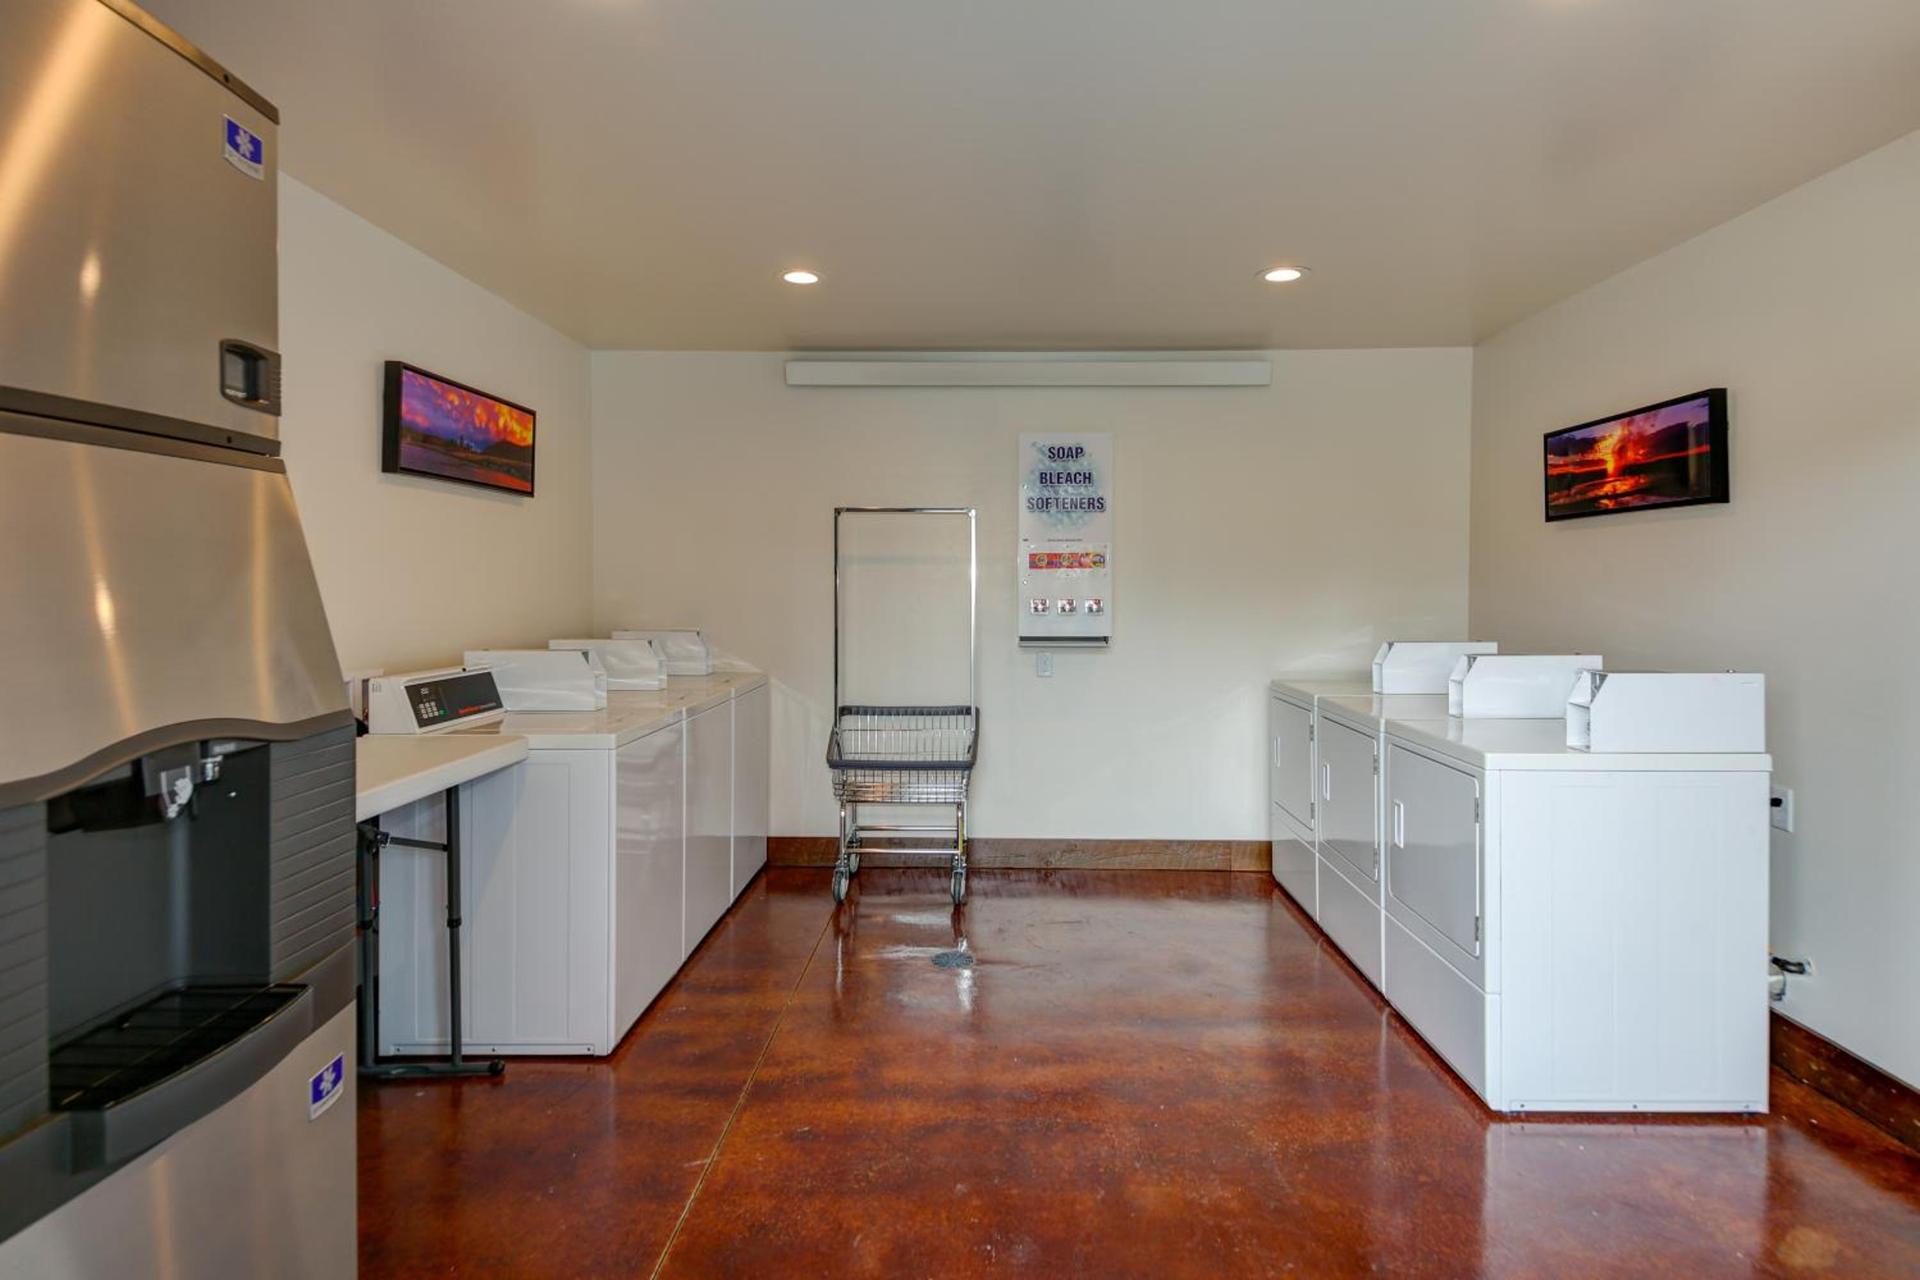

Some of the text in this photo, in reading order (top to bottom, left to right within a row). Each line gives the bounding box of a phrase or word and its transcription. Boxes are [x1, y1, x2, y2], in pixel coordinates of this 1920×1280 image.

[1047, 446, 1084, 460] SOAP
[1039, 471, 1092, 485] BLEACH
[1026, 496, 1105, 511] SOFTENERS
